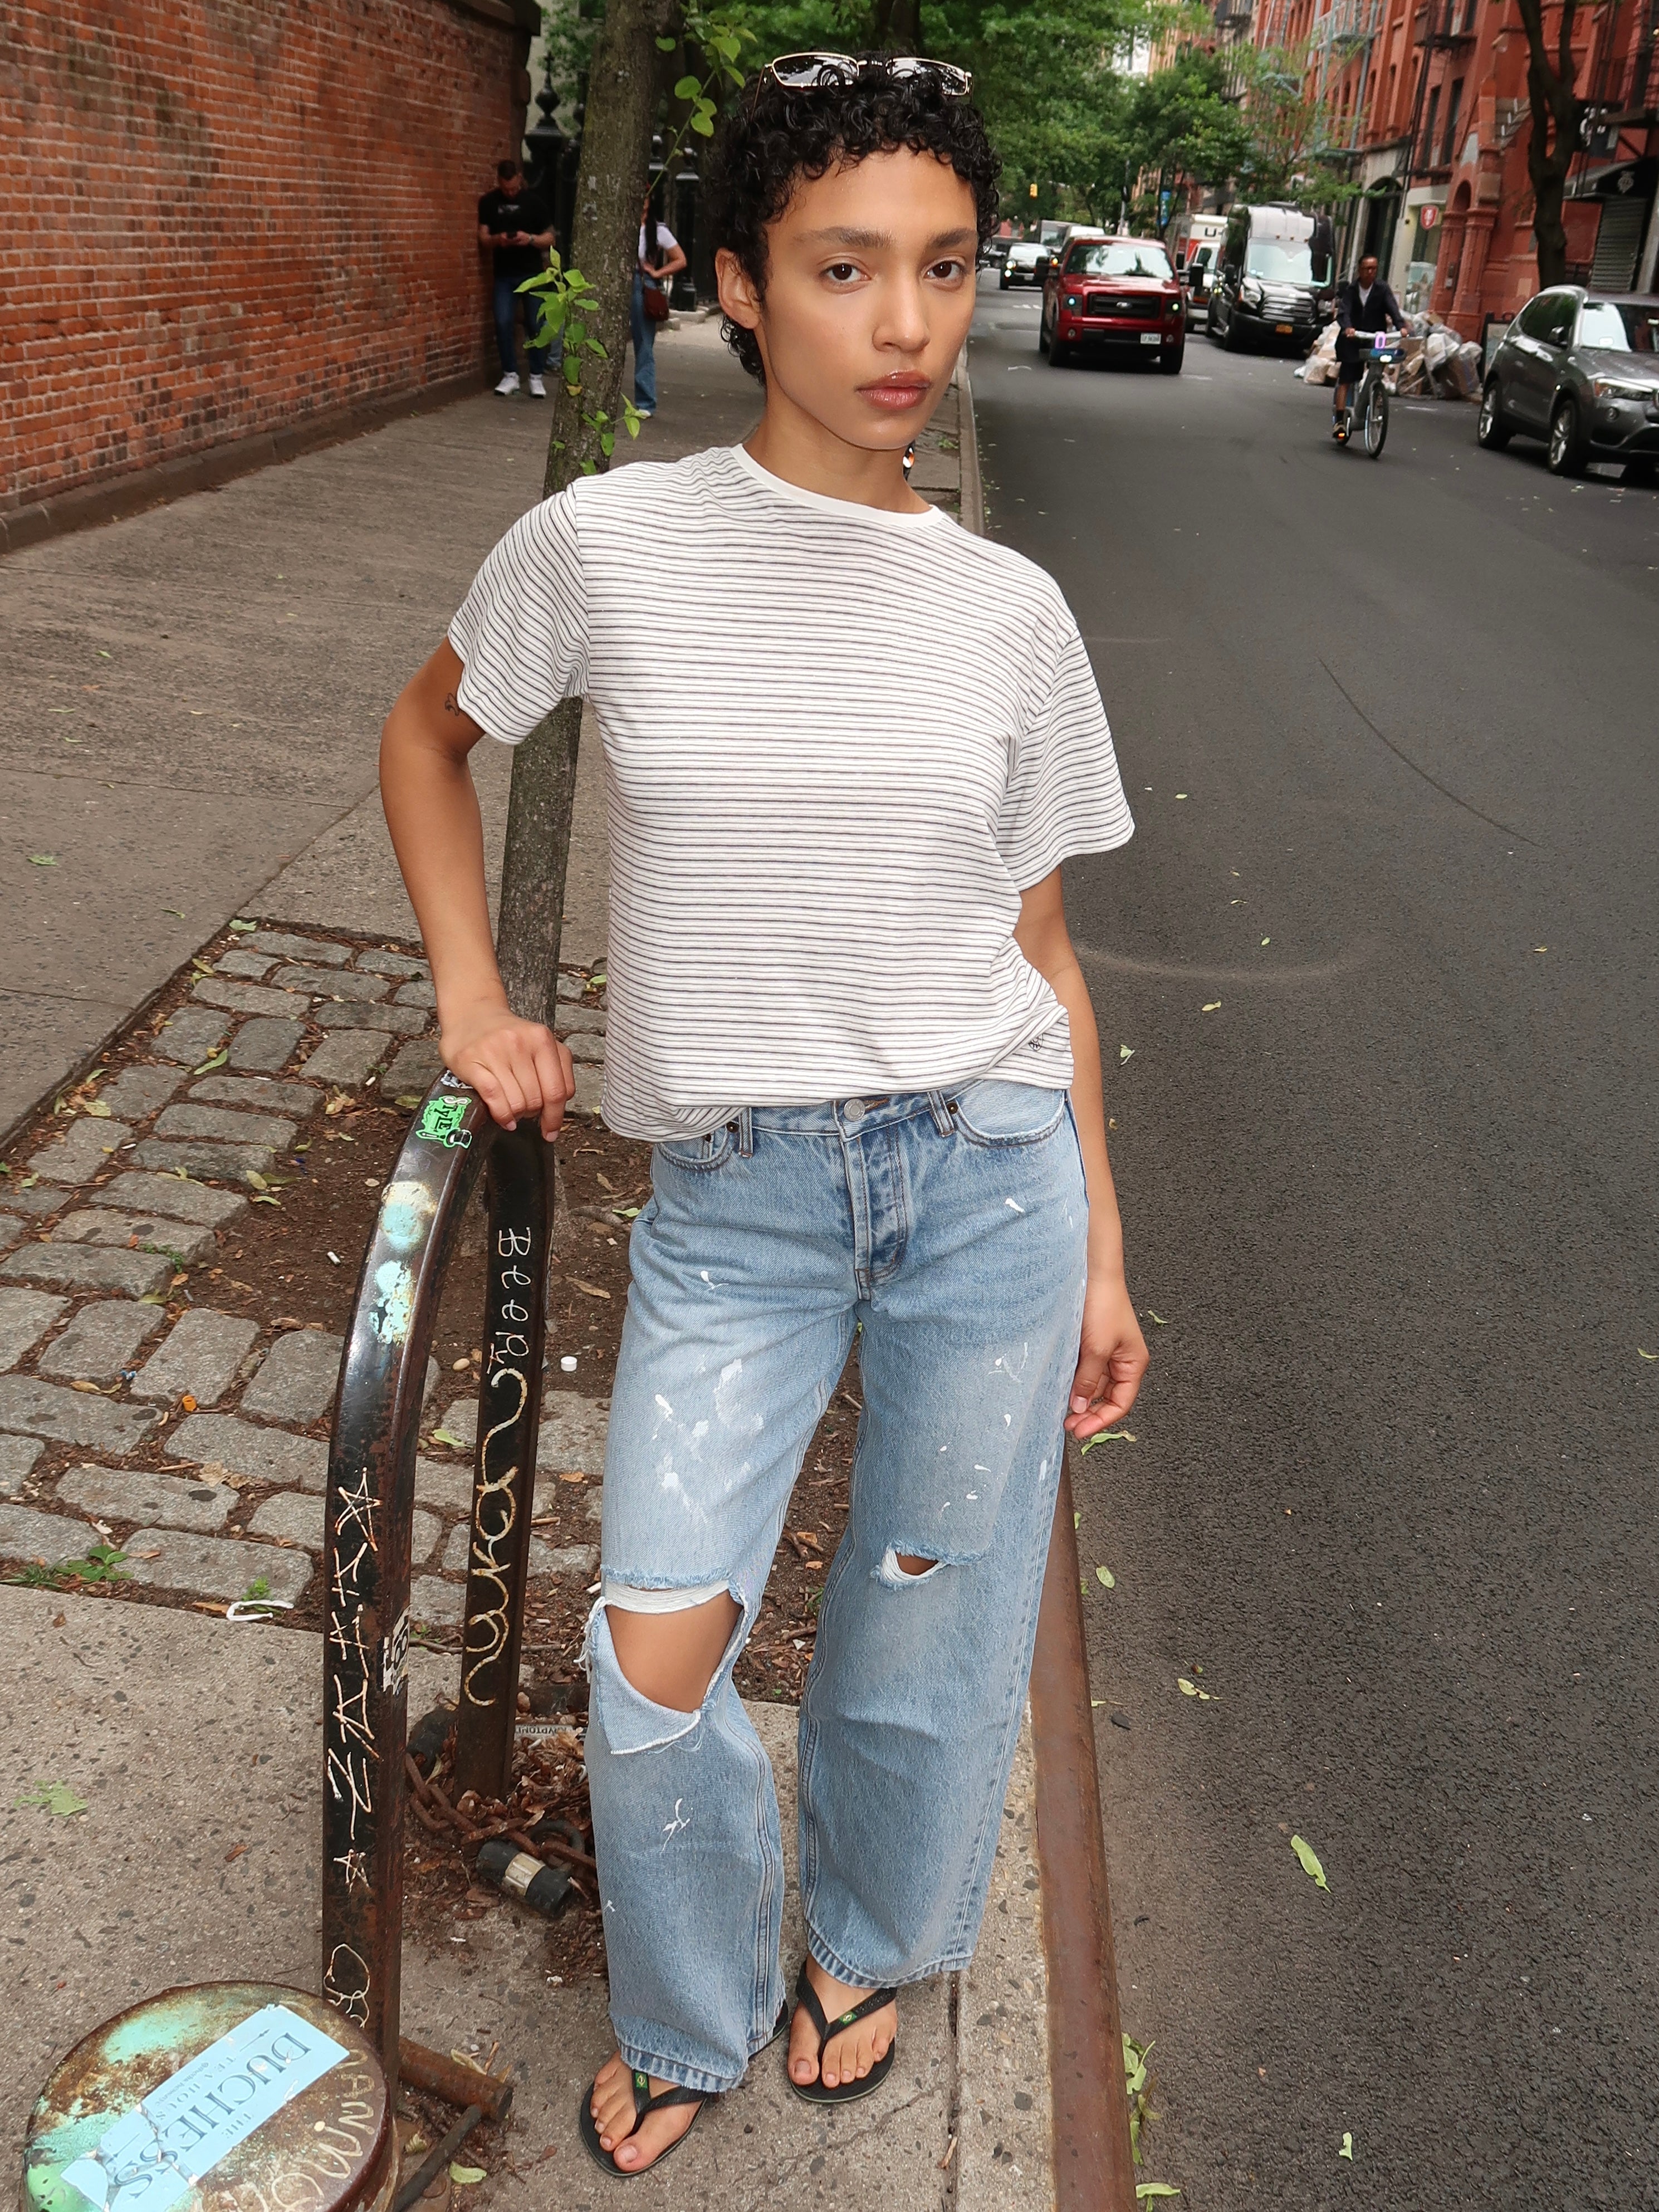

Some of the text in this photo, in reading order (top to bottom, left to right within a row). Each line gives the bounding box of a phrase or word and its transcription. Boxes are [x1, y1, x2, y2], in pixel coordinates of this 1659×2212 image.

[114, 2033, 311, 2198] DUCHESS
[145, 2056, 237, 2129] TEA HOUSE
[221, 2112, 255, 2138] THE
